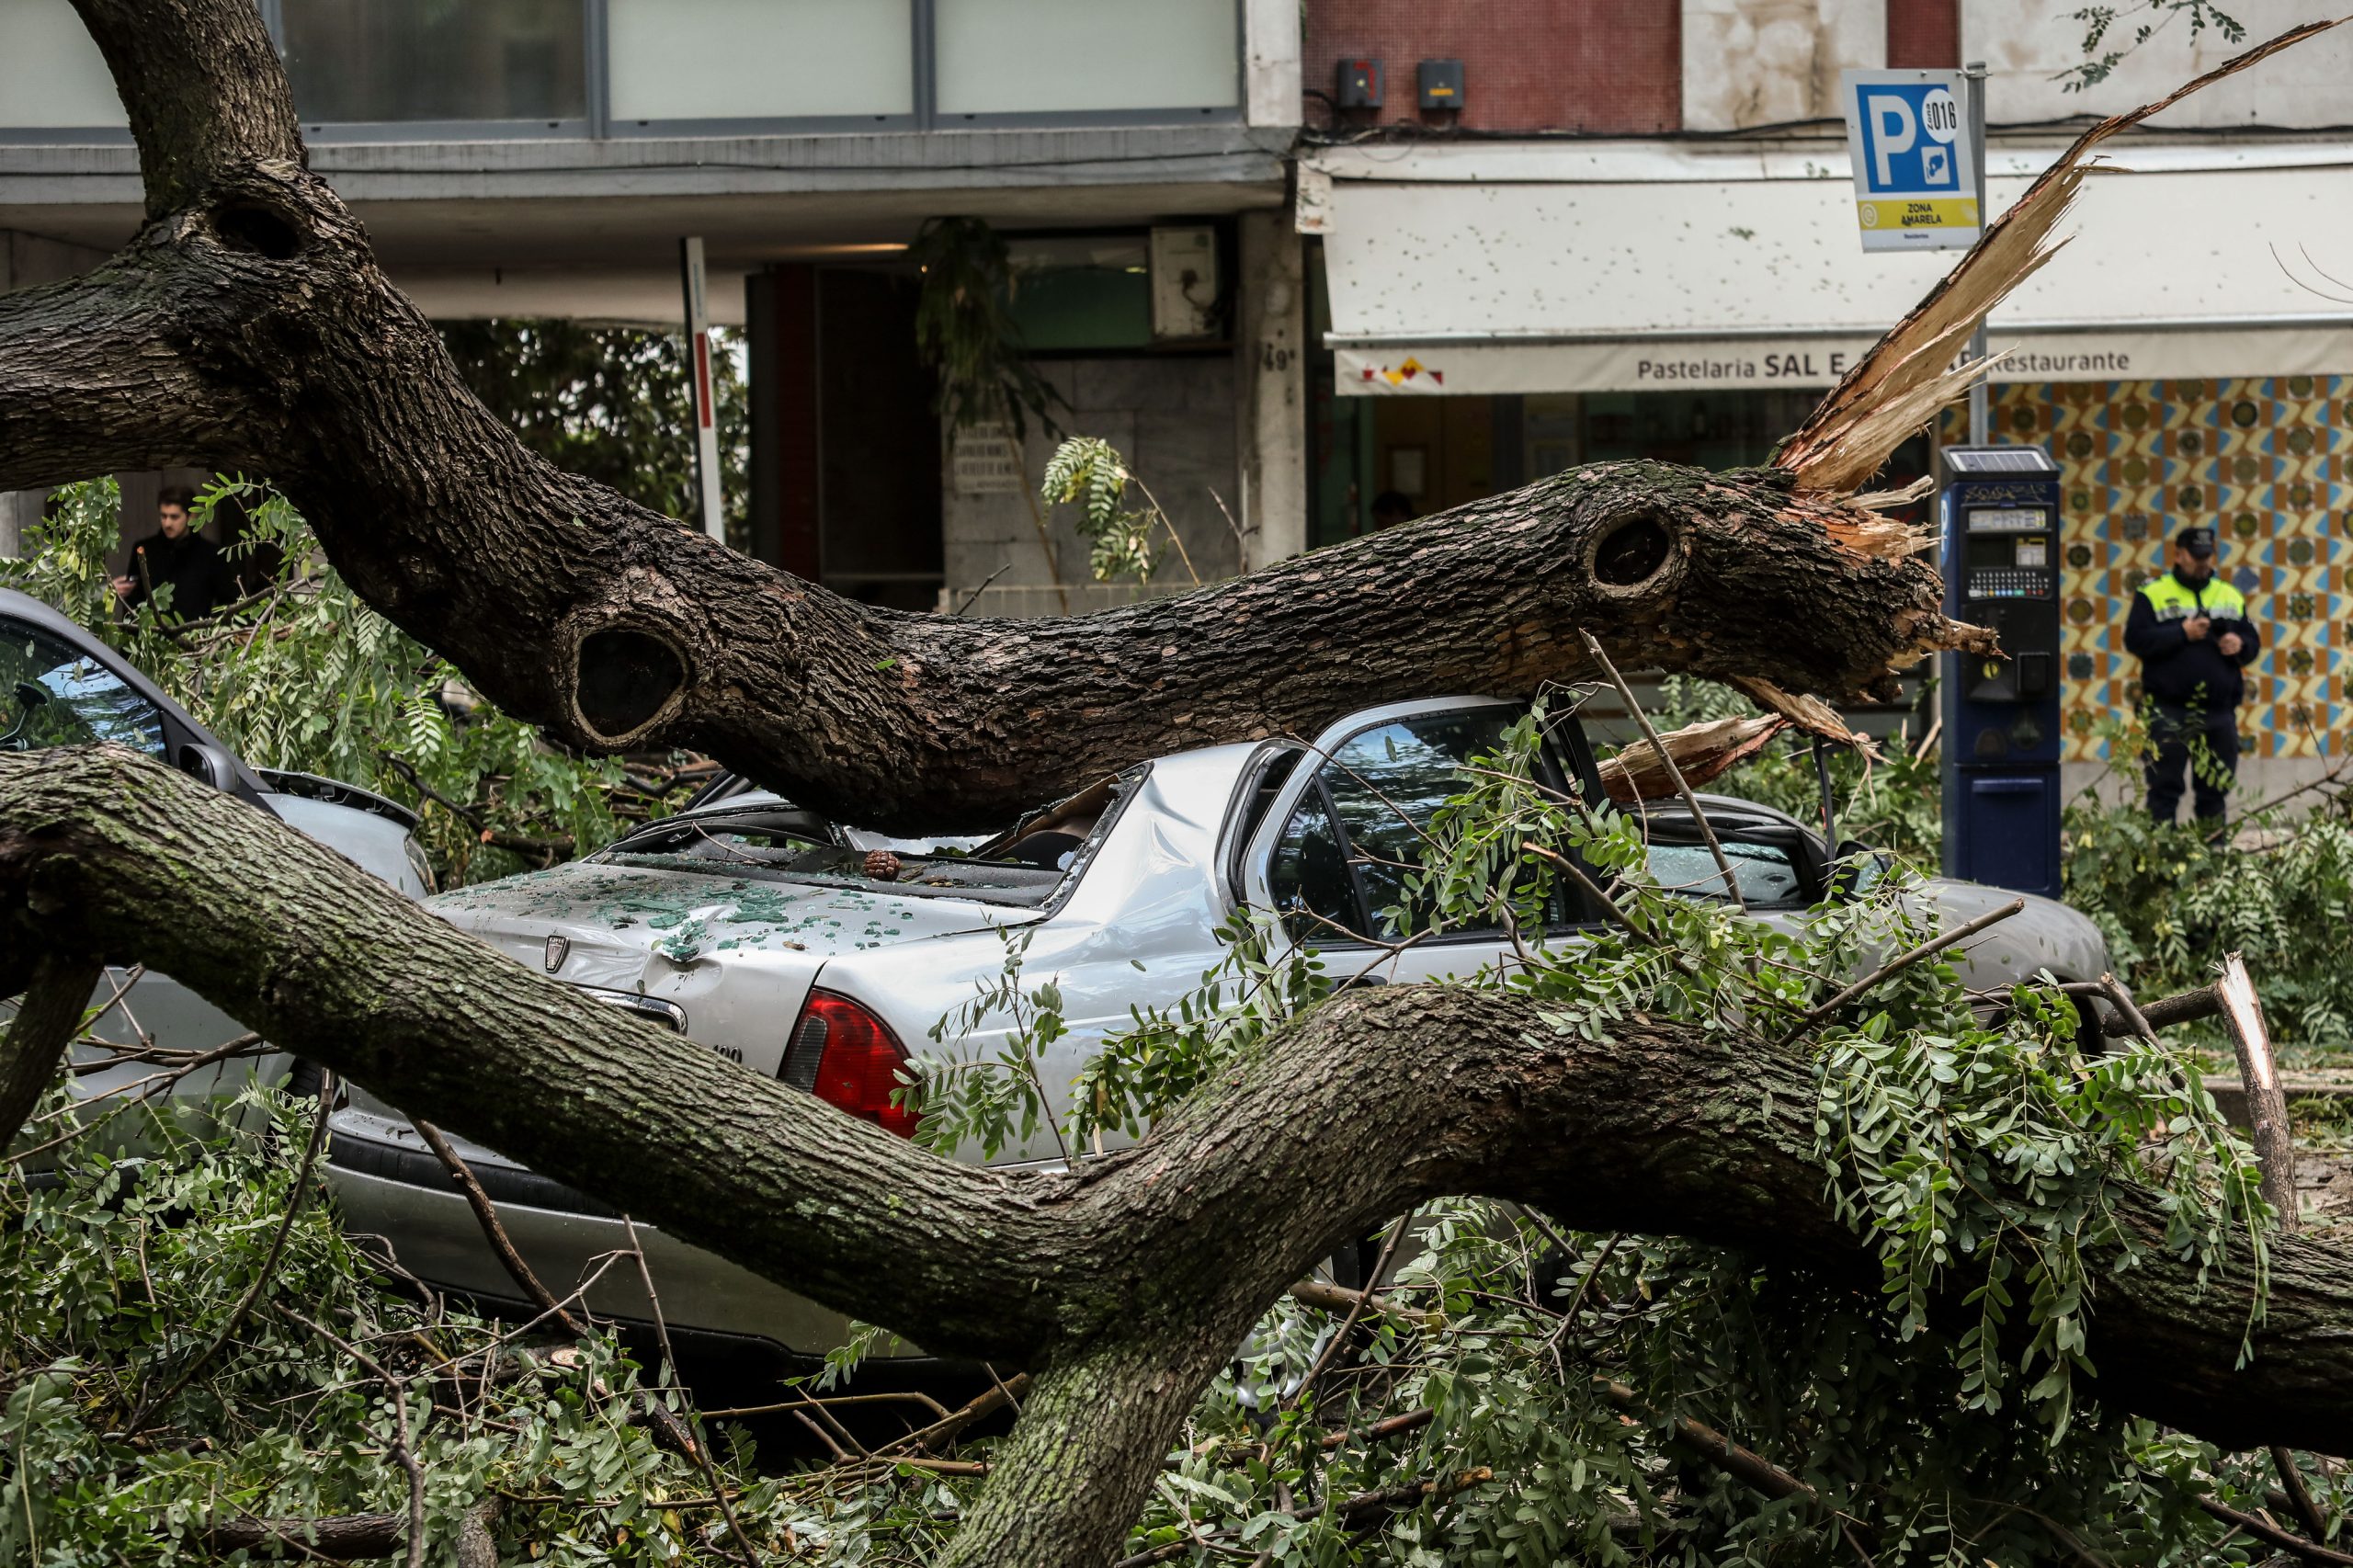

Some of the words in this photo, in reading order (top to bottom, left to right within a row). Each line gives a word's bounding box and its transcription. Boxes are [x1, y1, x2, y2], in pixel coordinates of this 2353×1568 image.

[1932, 101, 1957, 131] 016
[1868, 95, 1916, 185] P
[1901, 215, 1942, 225] AMARELA
[1907, 203, 1933, 213] ZONA
[1638, 358, 1756, 380] Pastelaria
[1765, 354, 1818, 377] SAL
[1830, 354, 1845, 375] E
